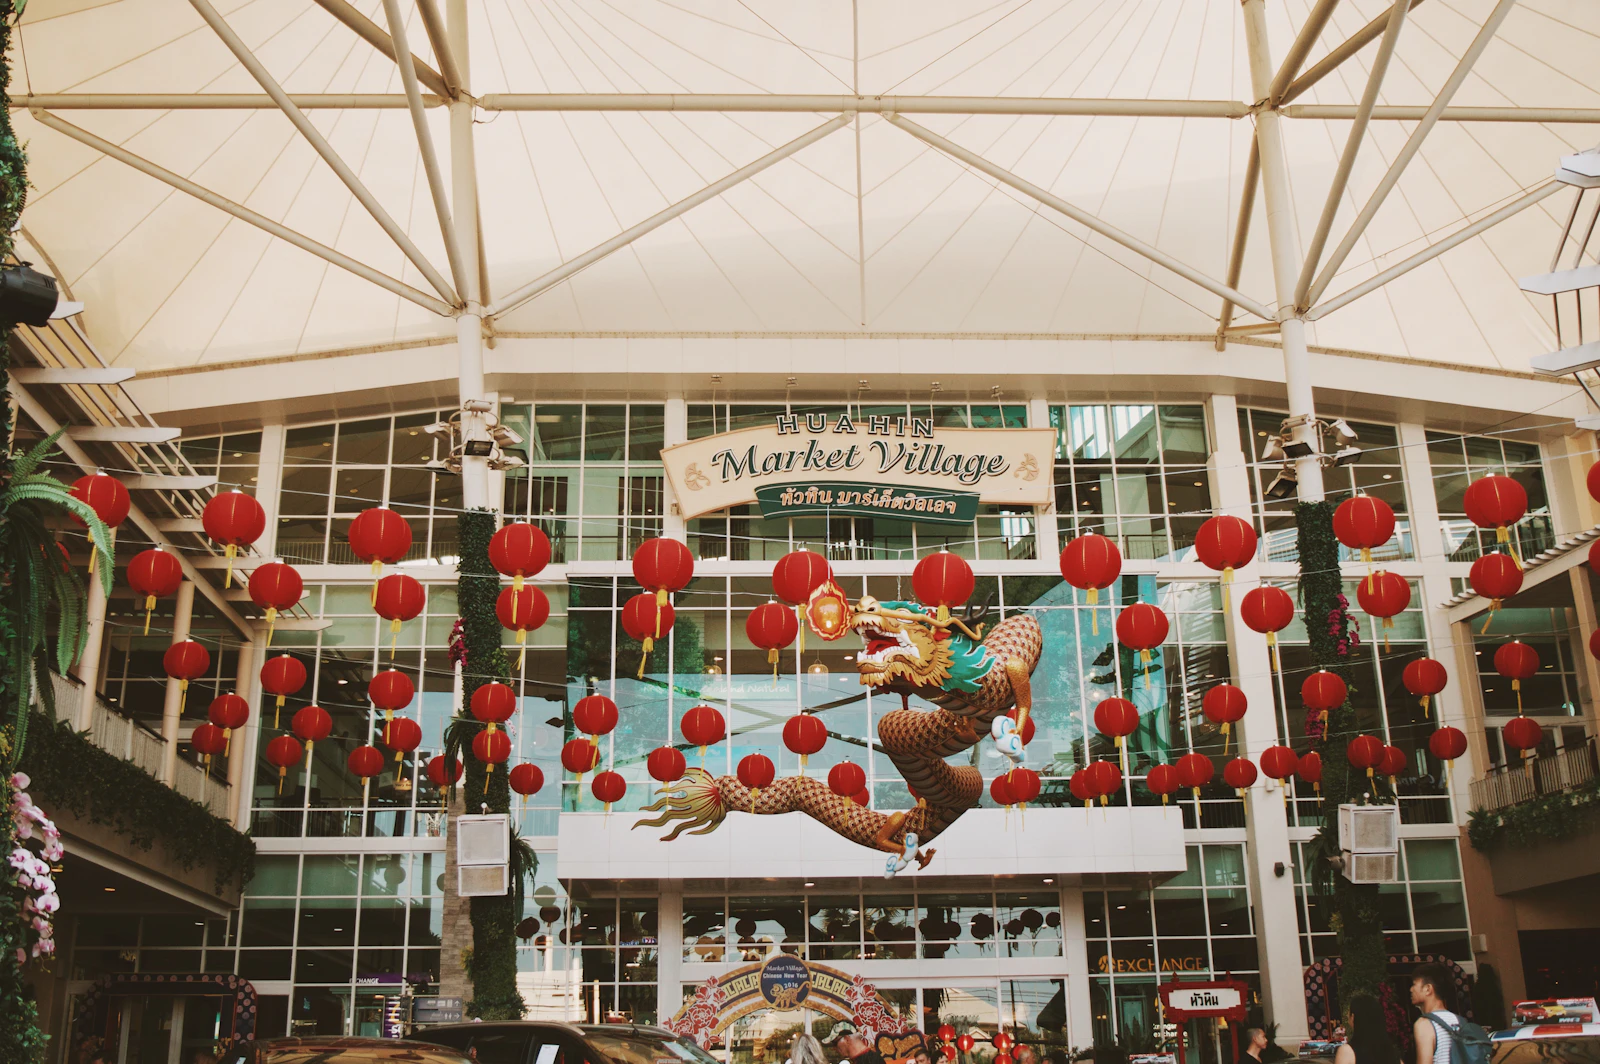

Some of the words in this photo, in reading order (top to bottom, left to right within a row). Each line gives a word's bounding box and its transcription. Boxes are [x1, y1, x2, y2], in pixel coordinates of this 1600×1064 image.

[776, 413, 856, 434] HUA
[869, 414, 935, 438] HIN
[710, 439, 864, 482] Market
[868, 440, 1011, 485] Village
[779, 486, 833, 506] หัวหิน
[1117, 957, 1204, 972] EXCHANGE
[1190, 992, 1219, 1006] หัวหิน
